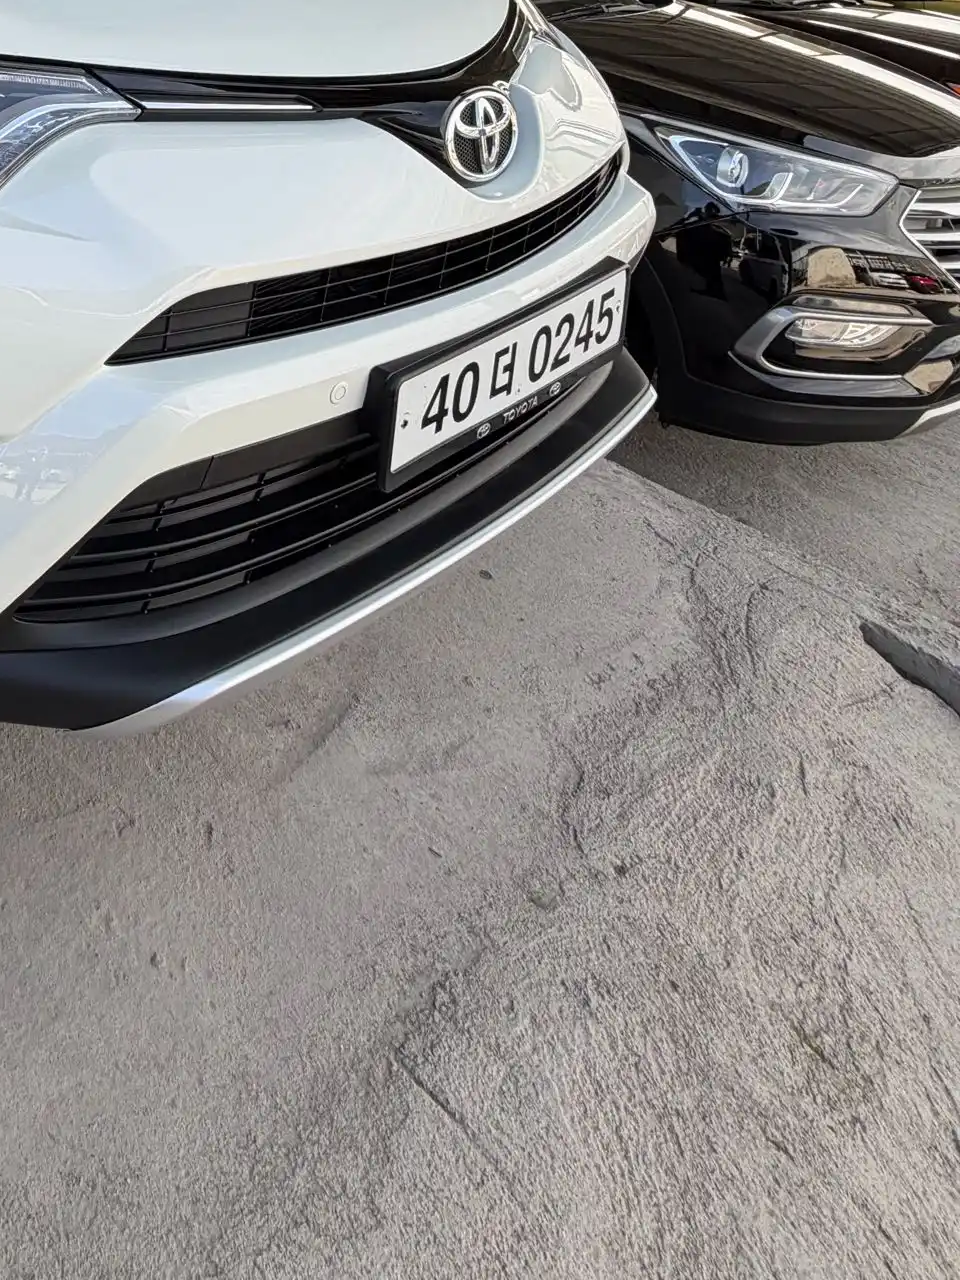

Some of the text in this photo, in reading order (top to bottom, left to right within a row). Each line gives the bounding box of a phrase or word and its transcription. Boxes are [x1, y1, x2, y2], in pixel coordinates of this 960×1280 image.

[421, 361, 480, 434] 40
[528, 287, 615, 383] 0245
[502, 396, 538, 425] TOYOTA
